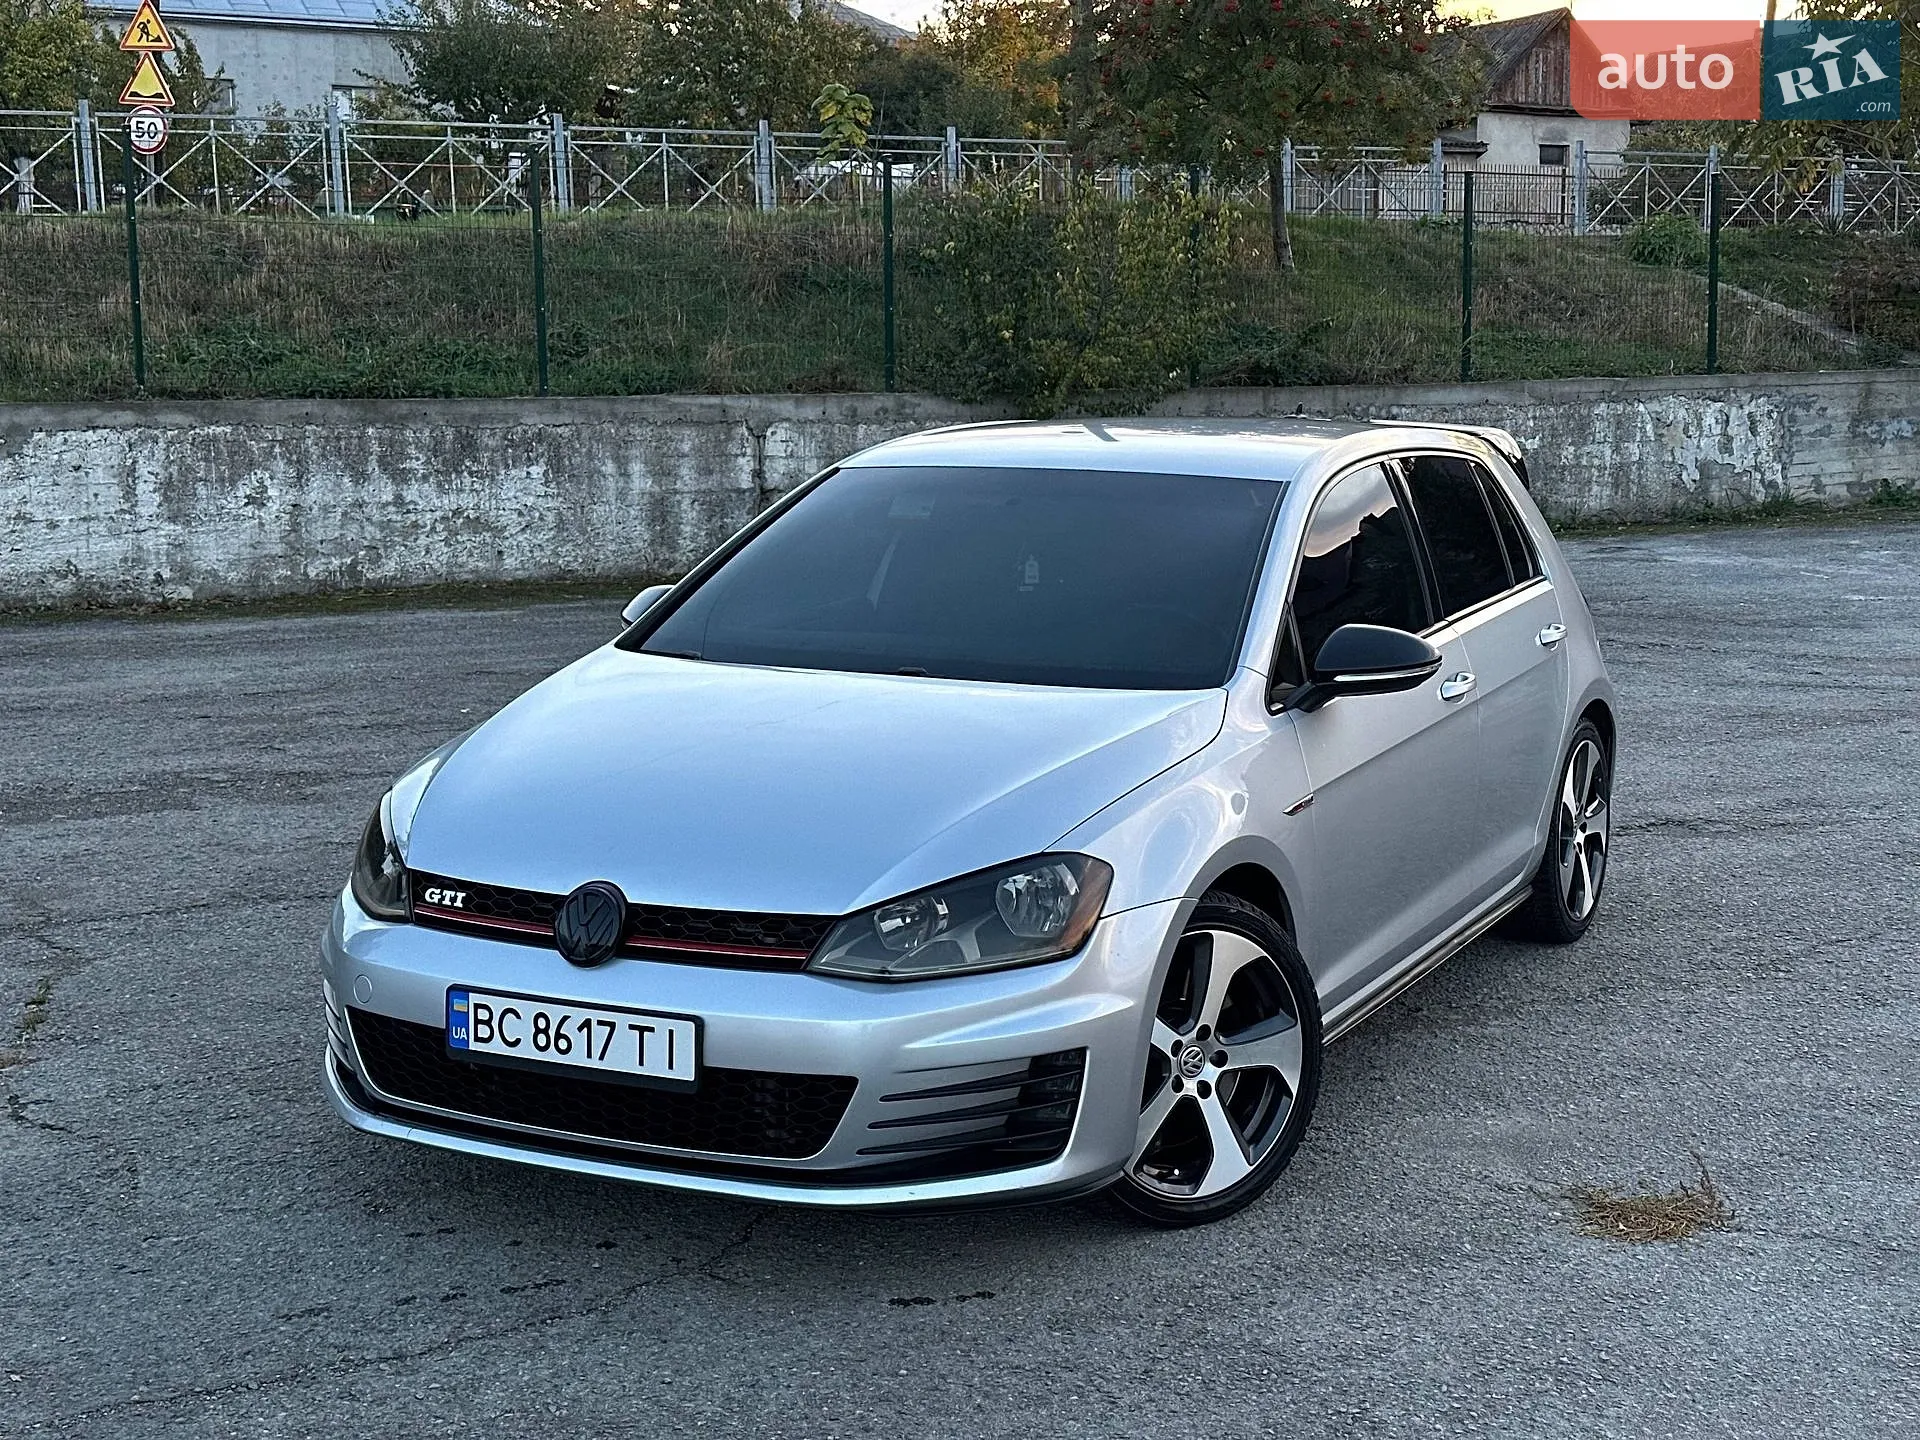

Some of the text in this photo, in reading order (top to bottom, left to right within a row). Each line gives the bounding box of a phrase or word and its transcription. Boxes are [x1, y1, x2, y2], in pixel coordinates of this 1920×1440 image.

[135, 120, 158, 139] 50
[424, 887, 467, 908] GTI
[452, 1026, 468, 1040] UA
[473, 1002, 674, 1070] BC 8617 TI
